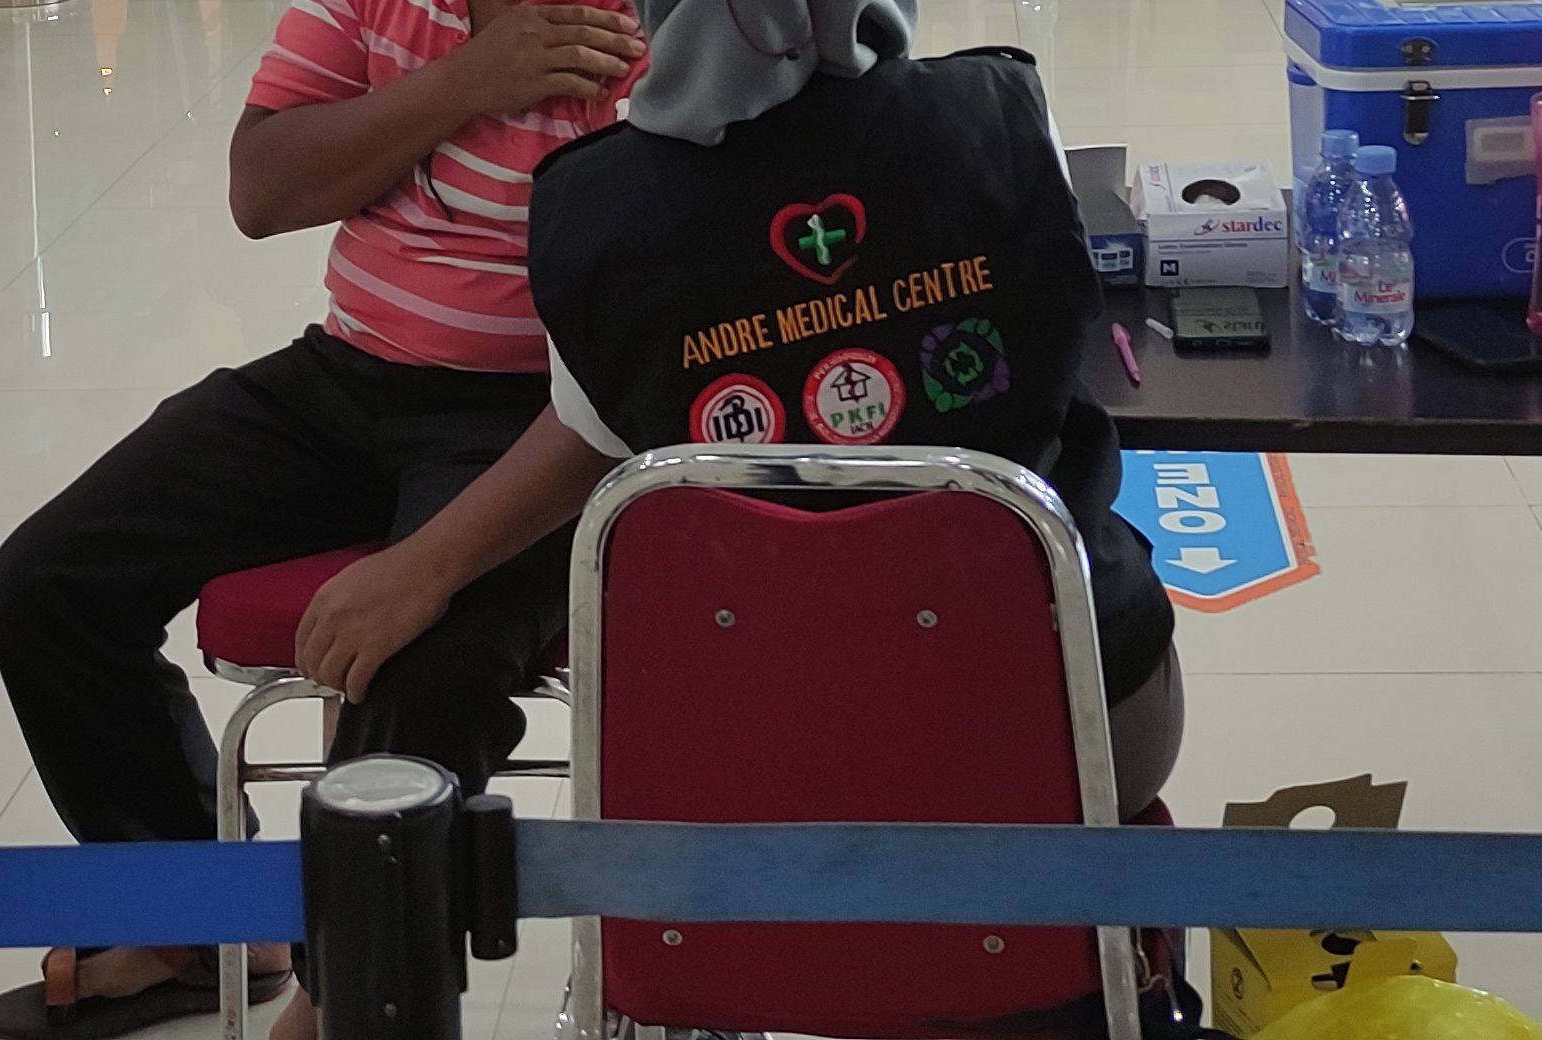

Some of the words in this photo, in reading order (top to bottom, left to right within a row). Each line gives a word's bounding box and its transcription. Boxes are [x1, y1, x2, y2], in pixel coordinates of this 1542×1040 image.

[1222, 216, 1283, 233] stardec
[682, 313, 774, 369] ANDRE
[776, 265, 888, 345] MEDICAL
[892, 255, 994, 313] CENTRE
[830, 403, 885, 428] PKFI
